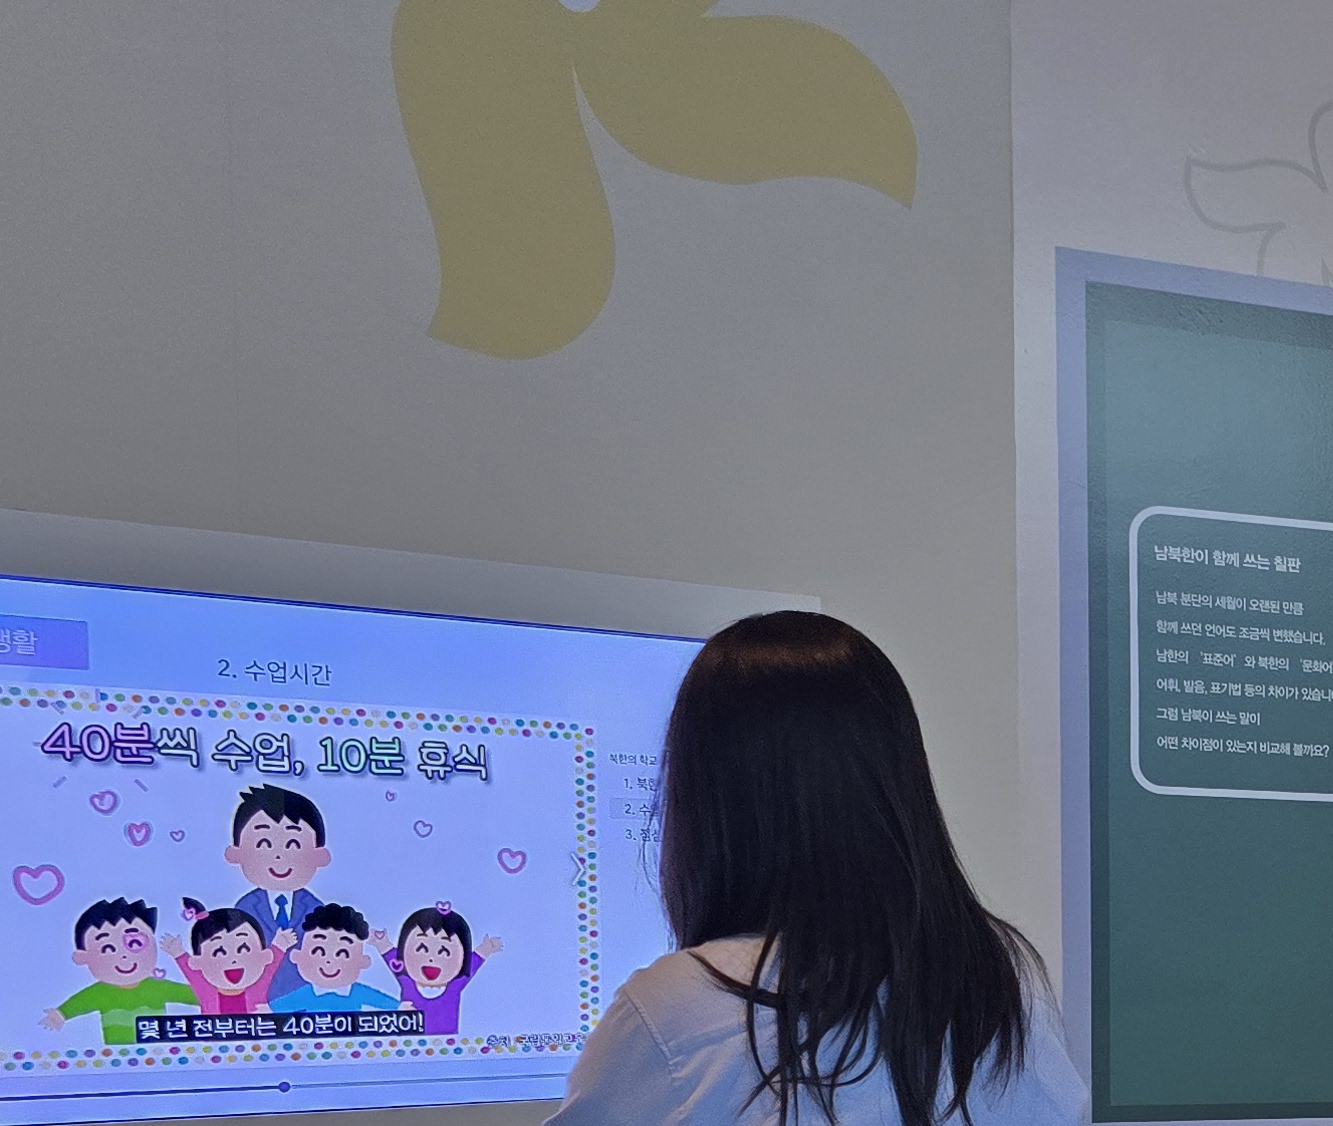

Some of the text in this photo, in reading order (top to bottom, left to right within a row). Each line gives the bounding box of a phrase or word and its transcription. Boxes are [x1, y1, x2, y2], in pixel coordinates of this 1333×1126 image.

[1154, 545, 1302, 573] 남북한이 함께 쓰는 칠판
[1156, 591, 1178, 605] 남북
[1180, 592, 1213, 608] 분단의
[1215, 595, 1247, 611] 세월이
[1282, 601, 1305, 616] 만큼
[1156, 620, 1326, 646] 함께 쓰던 언어도 조금씩 변했습니다.
[217, 658, 333, 687] 2. 수업시간
[1156, 649, 1189, 664] 남한의
[1258, 657, 1290, 671] 북한의
[1210, 682, 1242, 697] 표기법
[1244, 684, 1266, 698] 등의
[1268, 685, 1299, 700] 차이가
[1156, 708, 1261, 726] 그럼 남북이 쓰는 말이
[39, 721, 490, 782] 40분씩 수업, 10분 휴식
[1156, 736, 1330, 757] 어떤 차이점이 있는지 비교해 볼까요?
[139, 1013, 425, 1040] 몇 년 전부터는 40분이 되었어!
